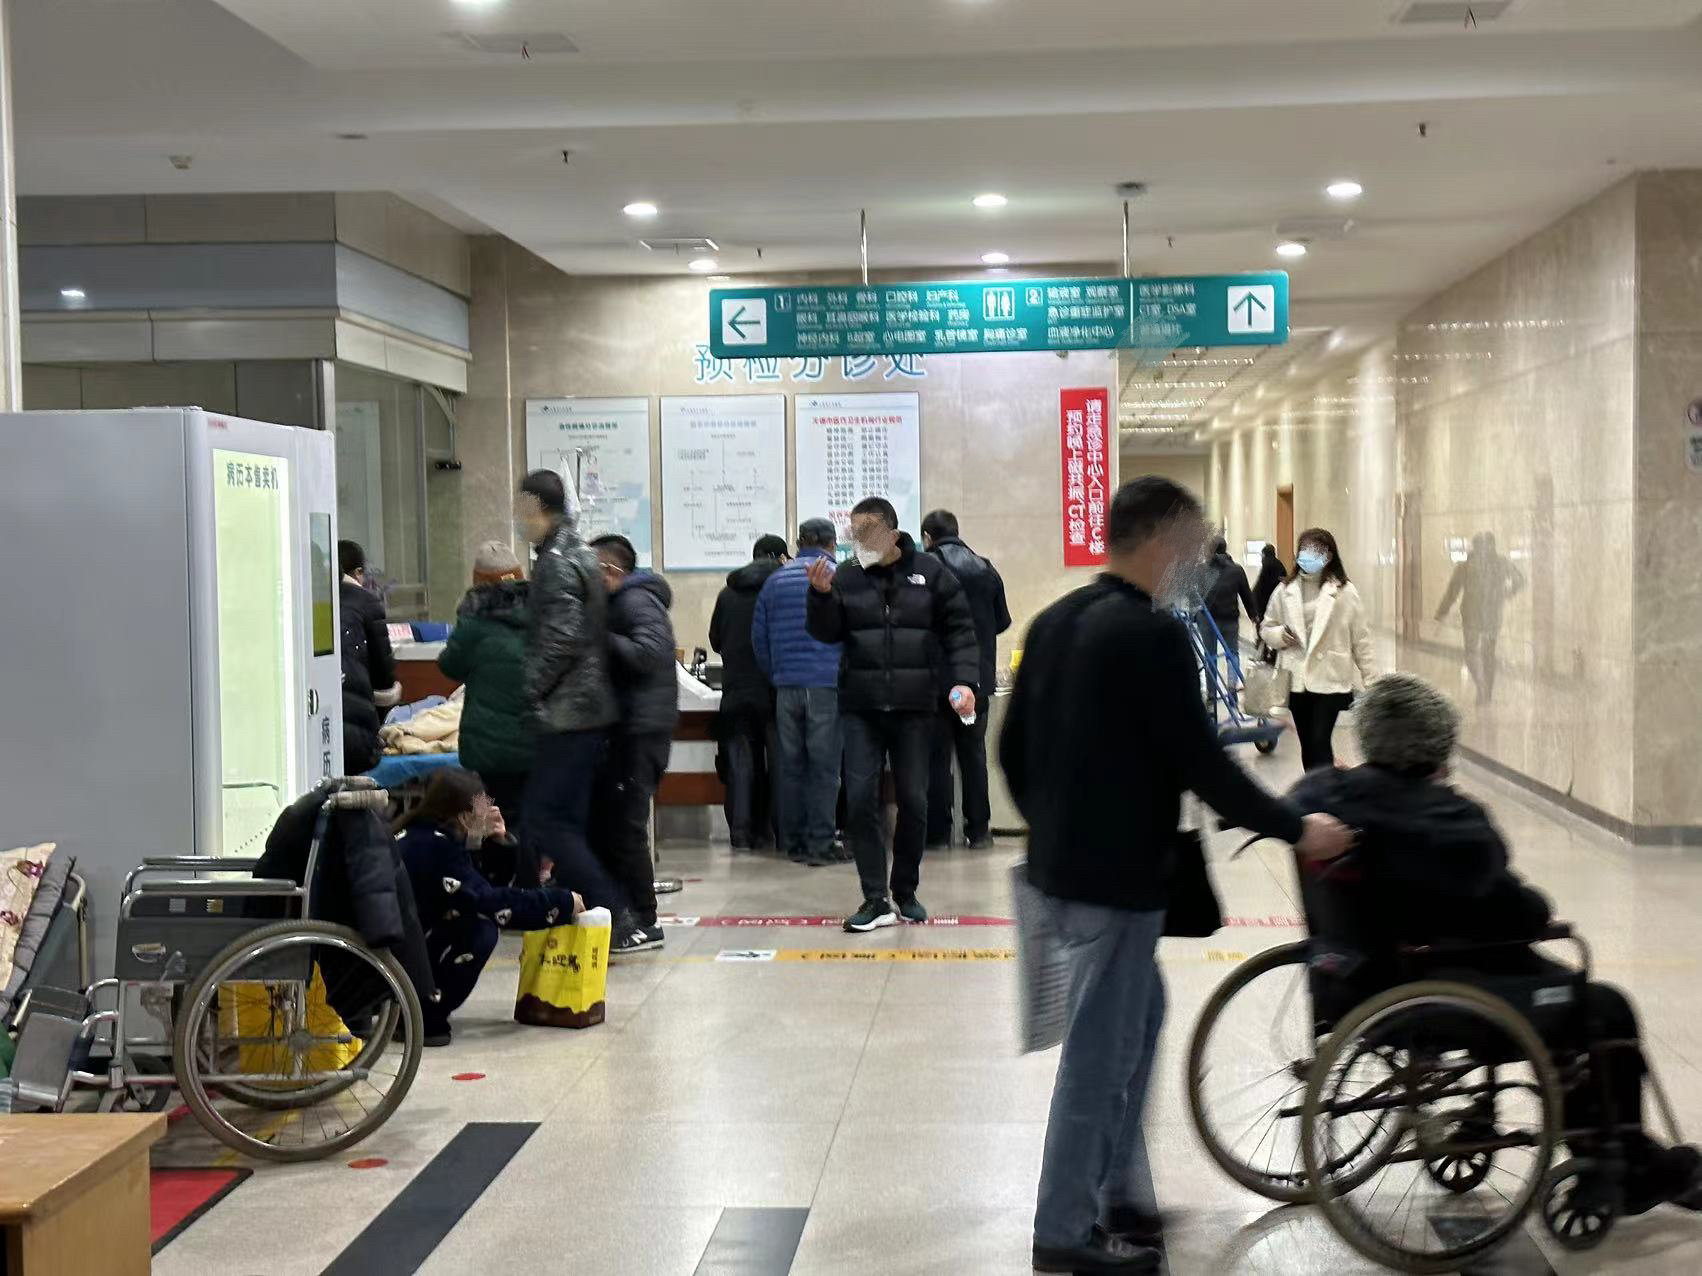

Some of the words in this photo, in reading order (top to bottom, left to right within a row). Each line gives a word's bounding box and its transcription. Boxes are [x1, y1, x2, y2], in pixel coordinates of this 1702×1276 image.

[694, 344, 928, 384] 预检分诊处
[226, 461, 279, 490] 病历本售卖机
